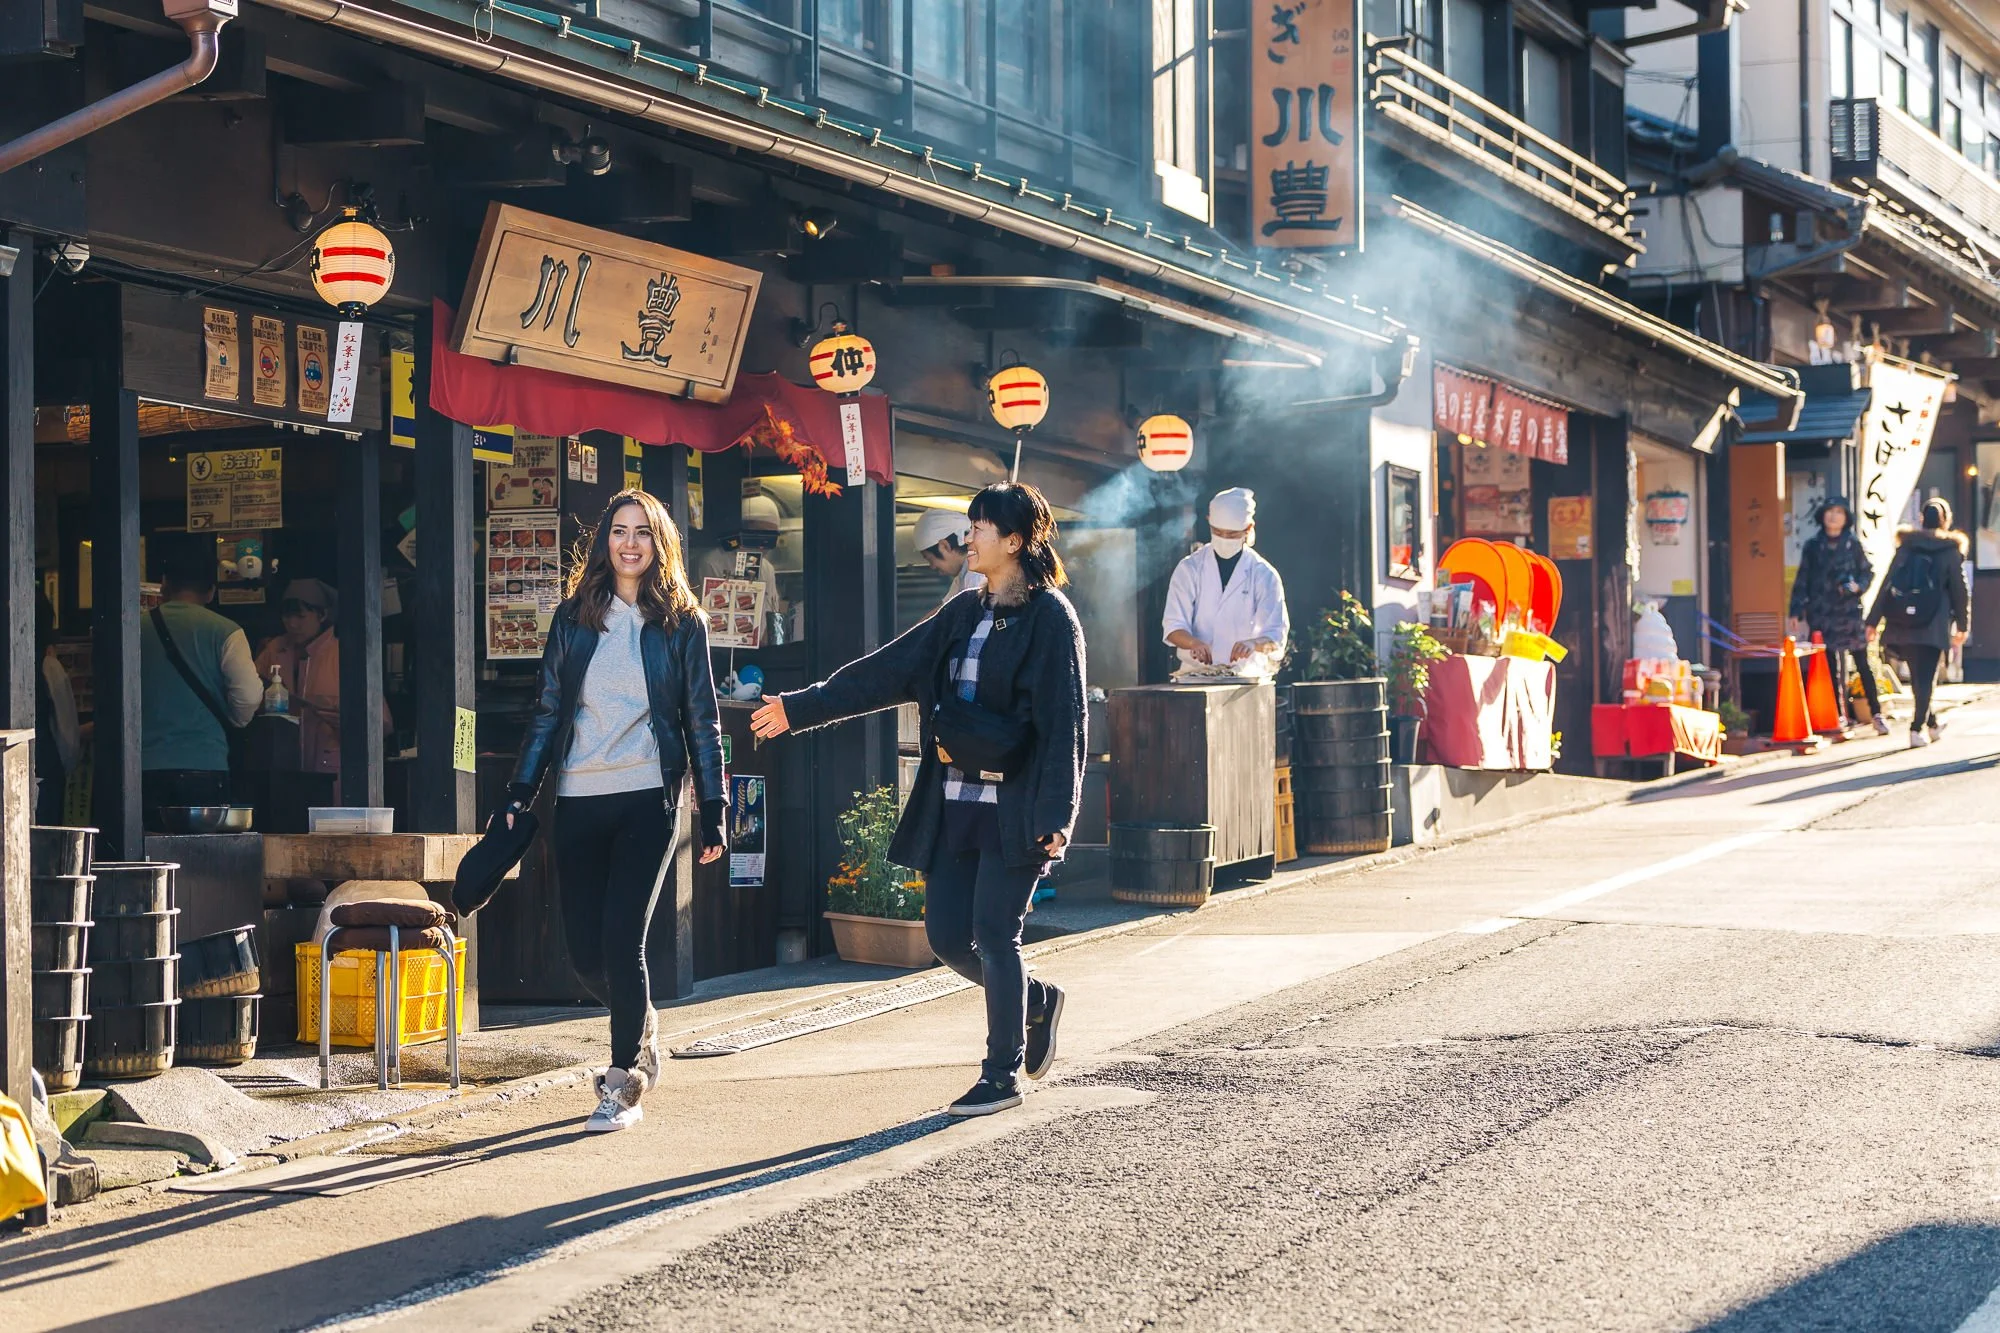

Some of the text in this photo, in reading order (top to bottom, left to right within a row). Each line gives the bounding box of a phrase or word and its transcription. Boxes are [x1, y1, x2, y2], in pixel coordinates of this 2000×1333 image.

[339, 333, 357, 397] 紅葉まつり
[830, 346, 865, 378] 仲
[221, 450, 262, 470] お会計
[846, 413, 860, 465] 紅葉まつり
